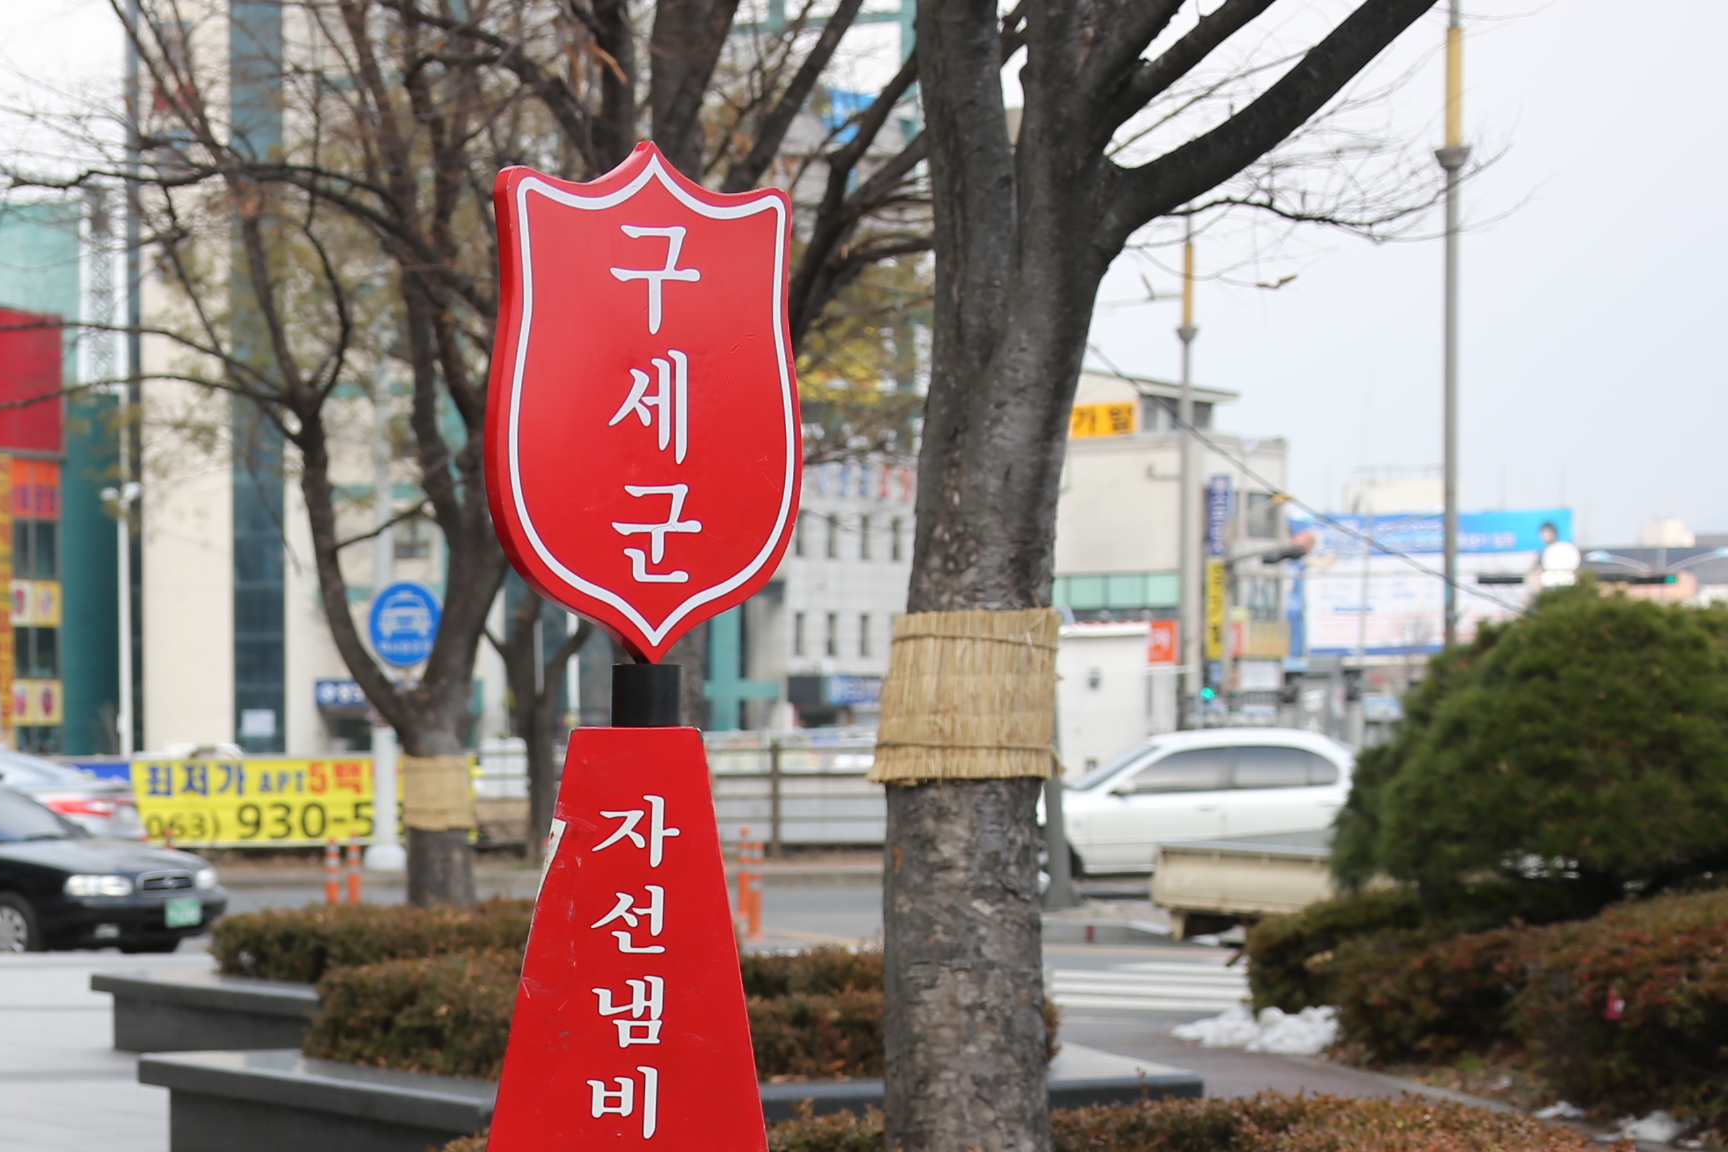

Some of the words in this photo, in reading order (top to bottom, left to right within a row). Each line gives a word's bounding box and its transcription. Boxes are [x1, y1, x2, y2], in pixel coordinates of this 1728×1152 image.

[609, 223, 702, 583] 구세군
[145, 765, 245, 797] 최저가
[259, 770, 305, 794] APT
[309, 763, 376, 795] 5백
[586, 794, 680, 1140] 자선냄비
